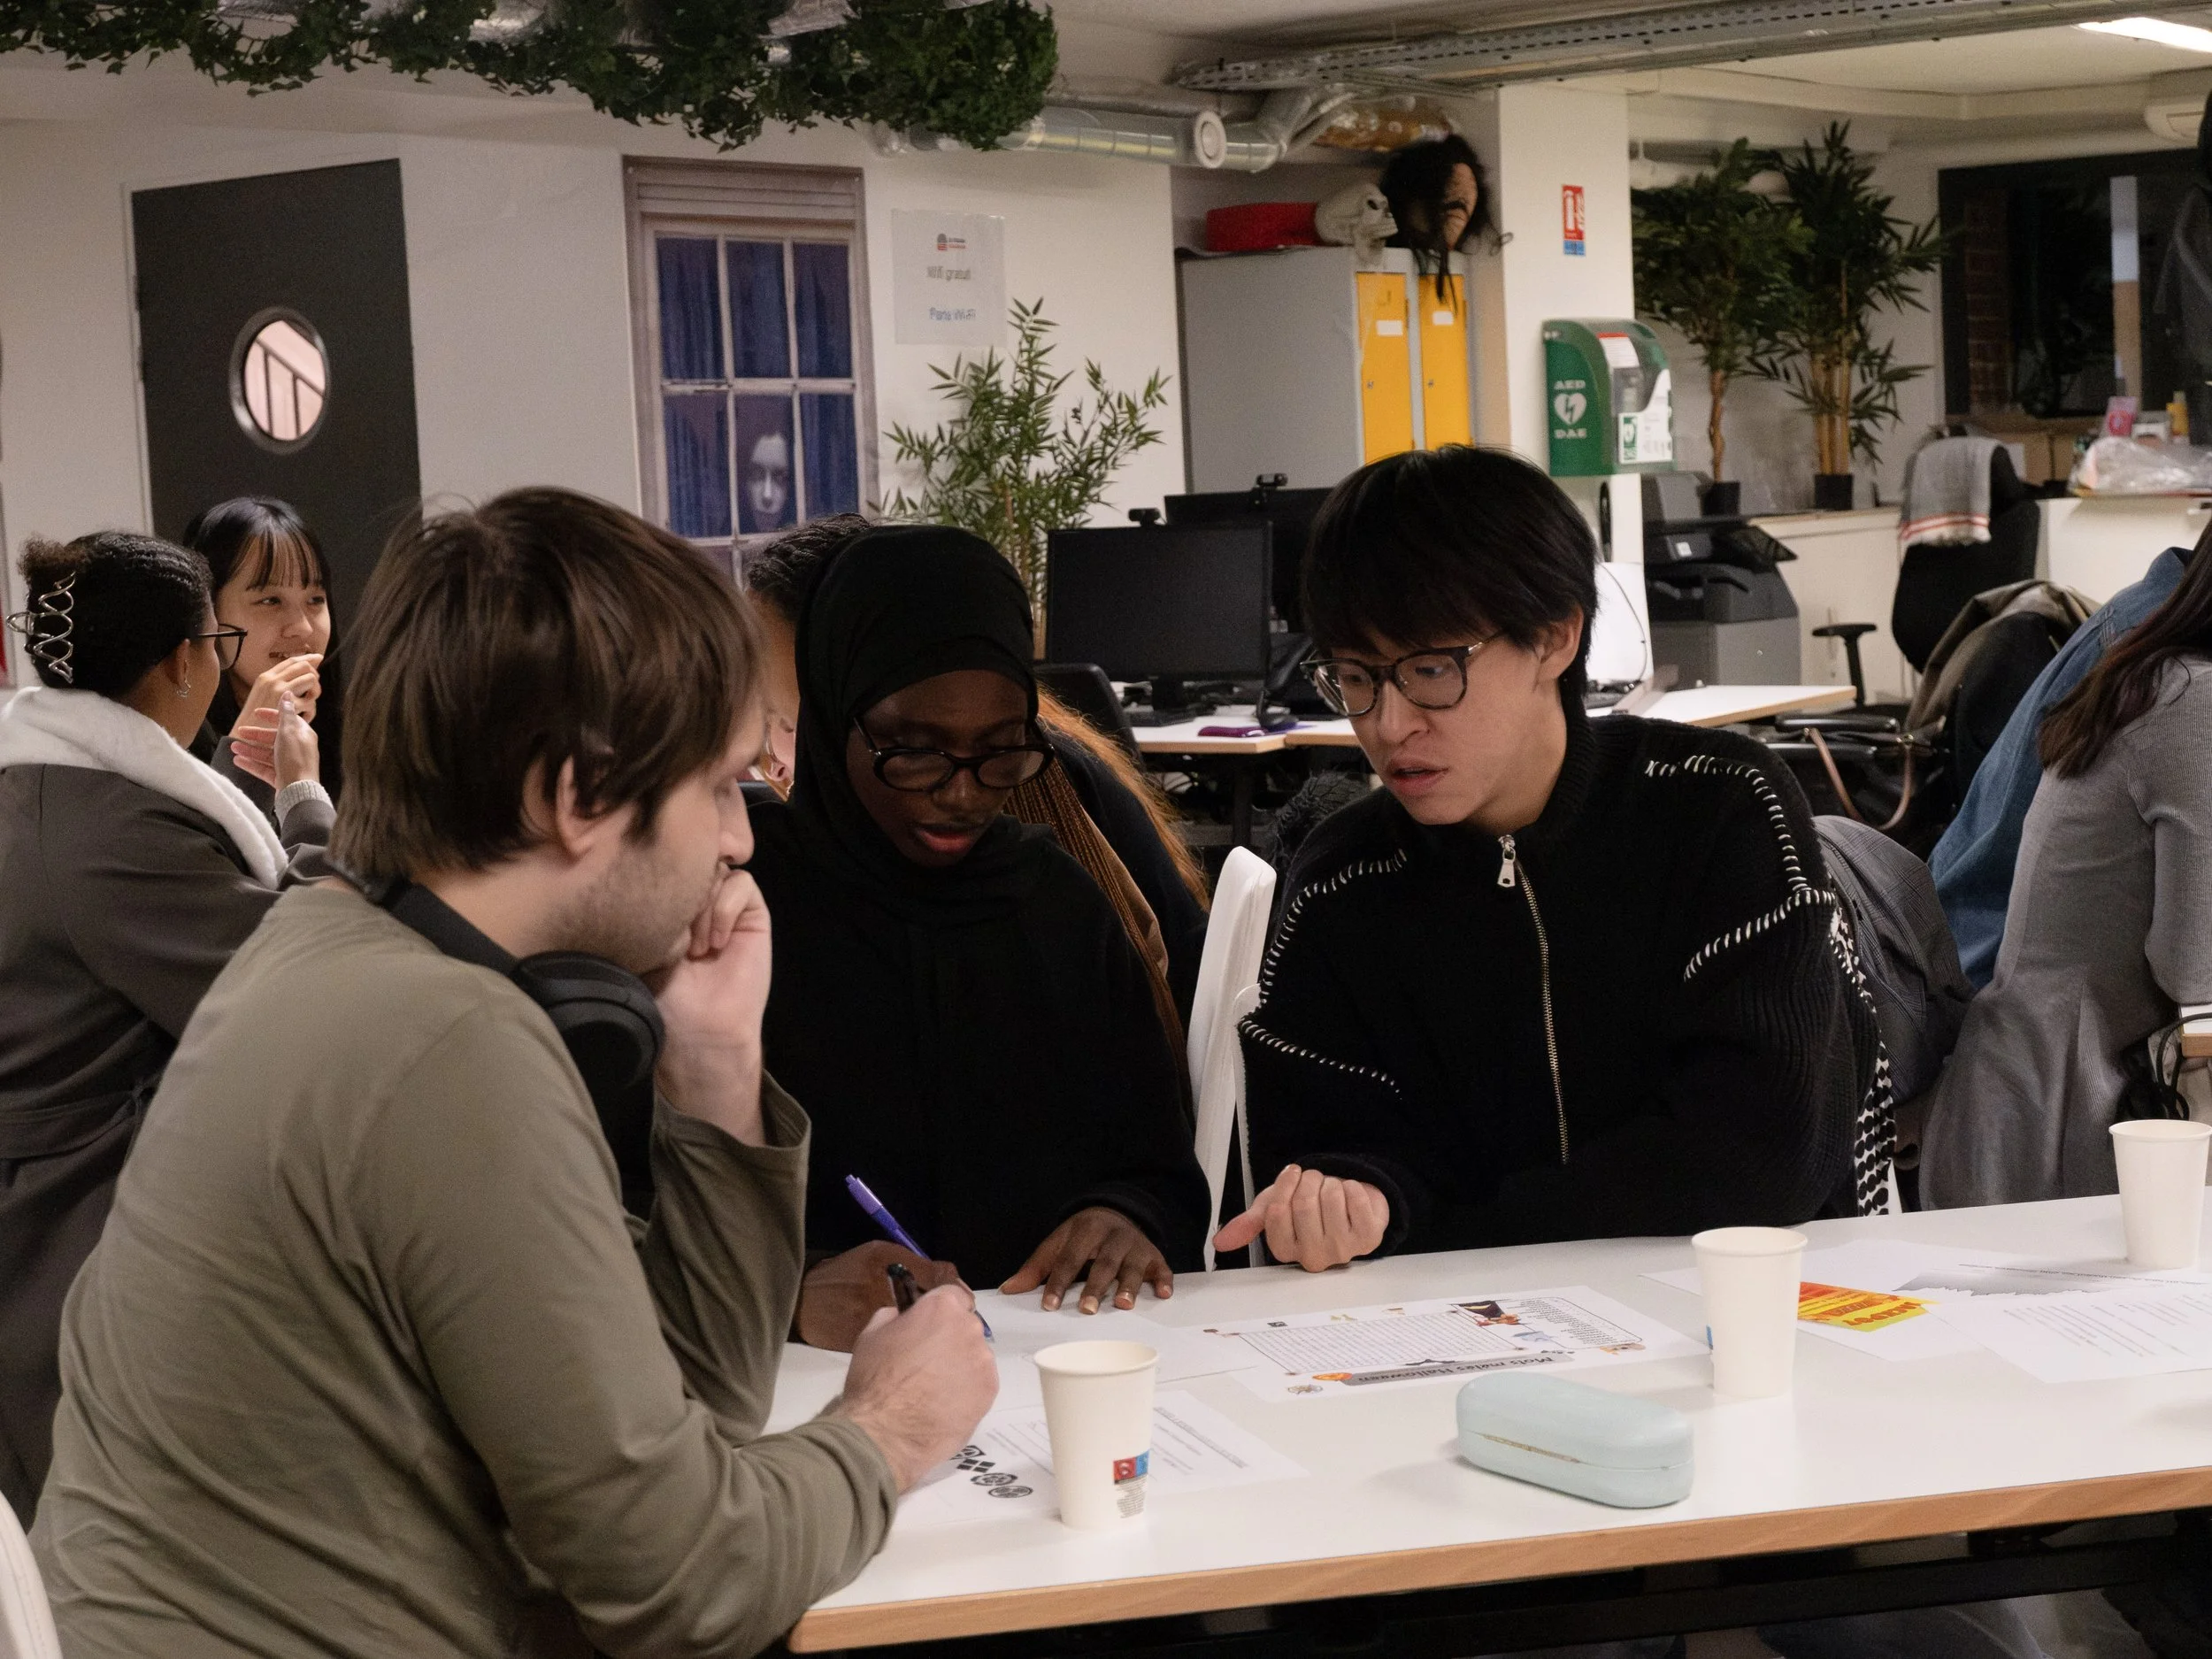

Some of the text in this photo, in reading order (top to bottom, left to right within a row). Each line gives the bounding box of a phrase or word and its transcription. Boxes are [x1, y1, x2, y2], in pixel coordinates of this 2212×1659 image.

[1554, 380, 1586, 390] AED
[1555, 428, 1587, 439] DAE
[1510, 1356, 1554, 1365] Mots
[1358, 1367, 1455, 1382] Halloween
